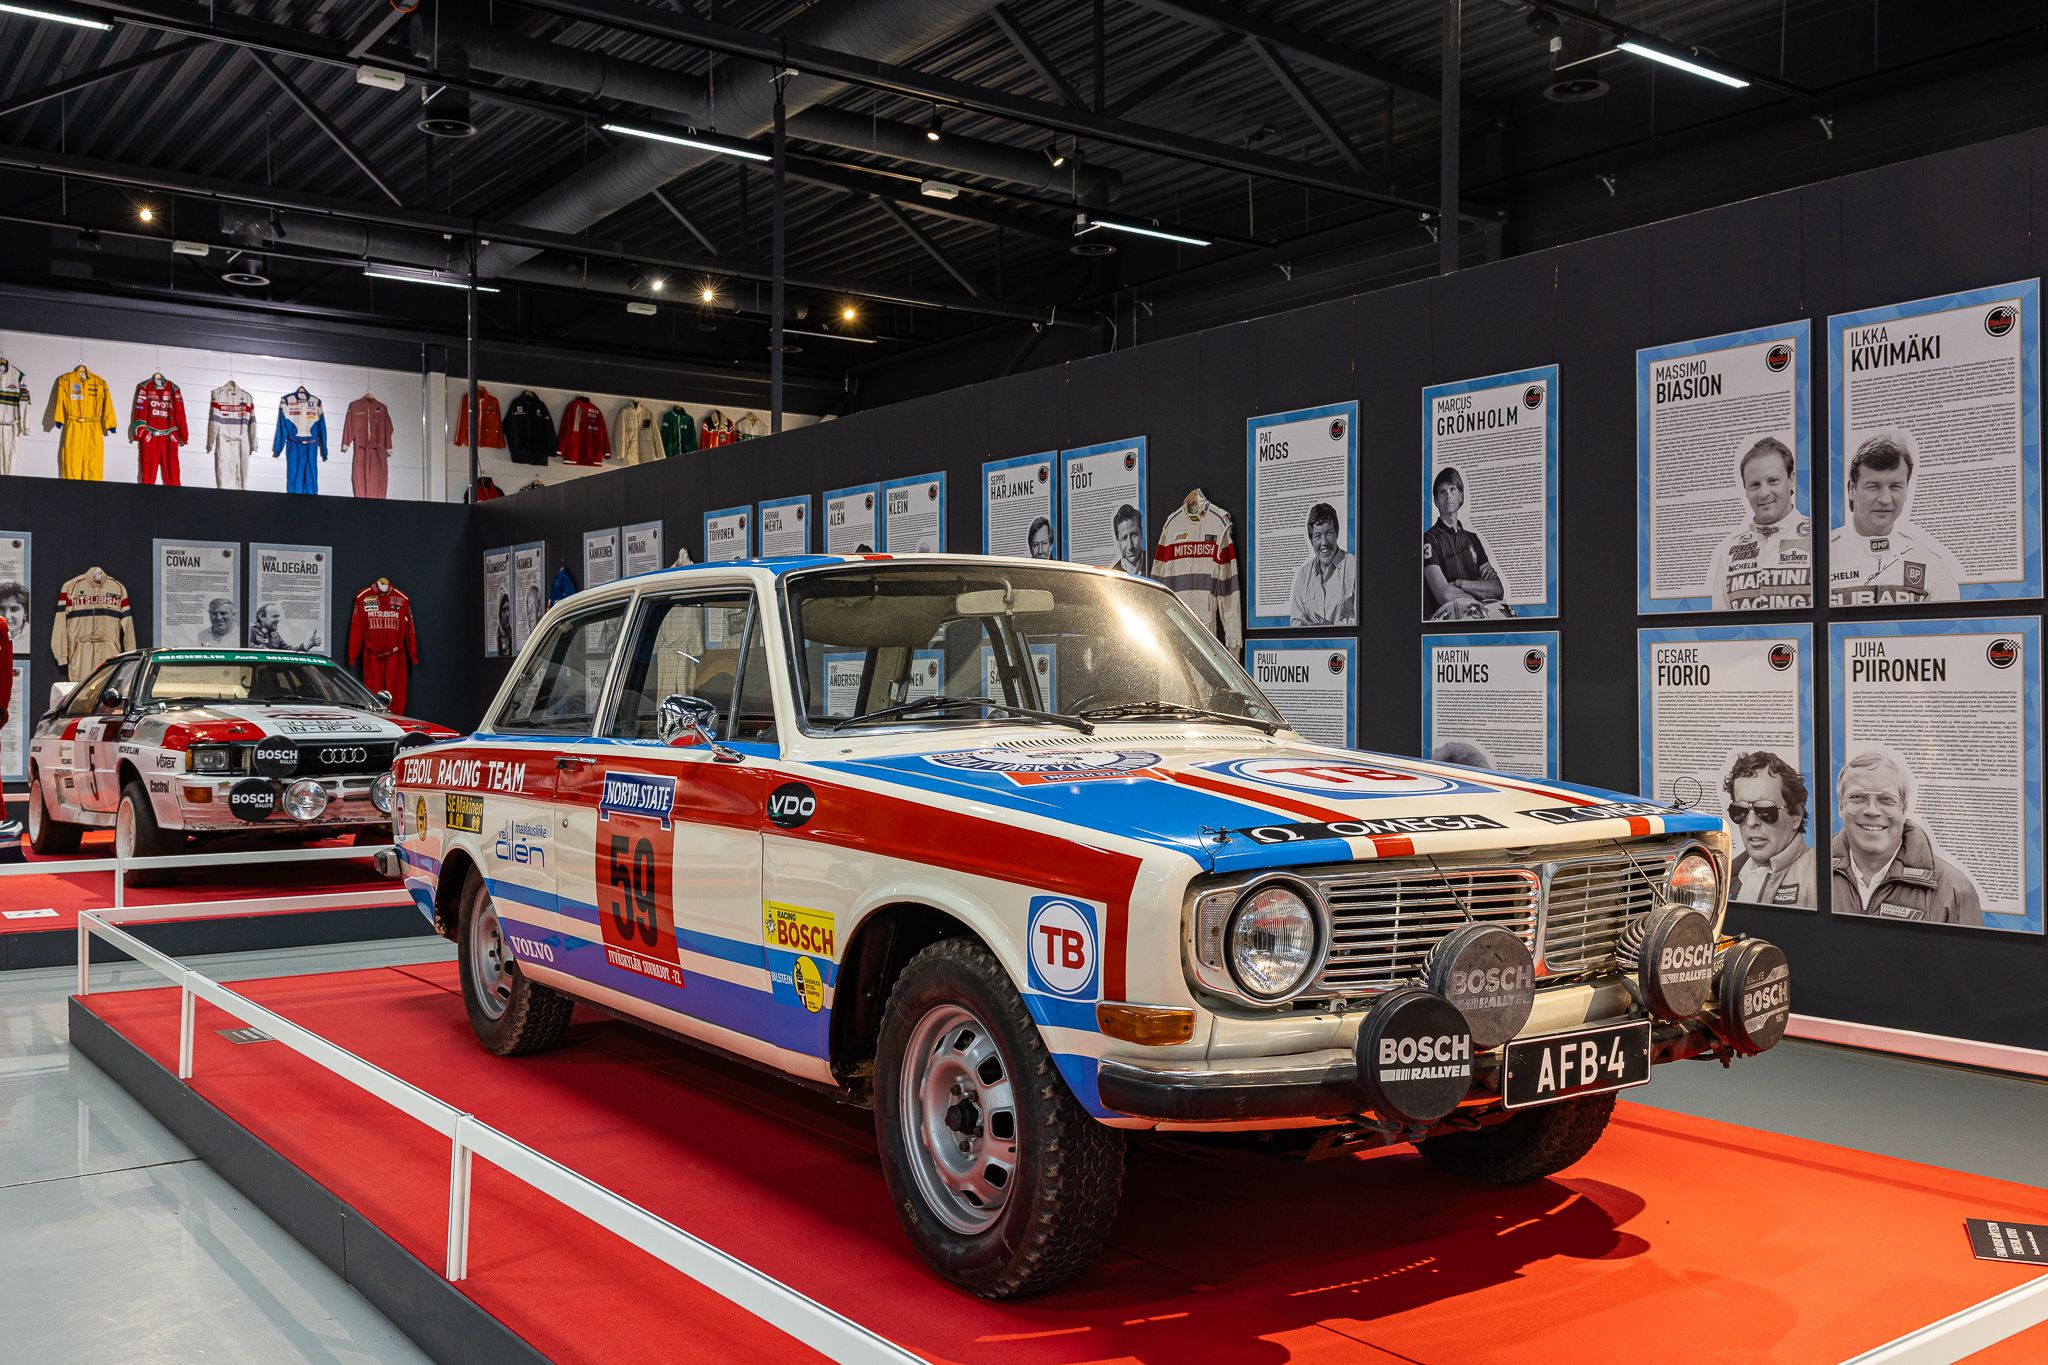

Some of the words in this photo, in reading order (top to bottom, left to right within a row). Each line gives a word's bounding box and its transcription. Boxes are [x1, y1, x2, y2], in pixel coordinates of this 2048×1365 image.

[1851, 326, 1888, 348] ILKKA
[1851, 334, 1941, 372] KIVIMÄKI
[1656, 360, 1707, 382] MASSIMO
[1656, 373, 1722, 404] BIASION
[1437, 396, 1472, 414] MARCUS
[1437, 406, 1518, 436] GRÖNHOLM
[1260, 431, 1272, 444] PAT
[1260, 442, 1289, 462] MOSS
[1070, 462, 1084, 475] JEAN
[991, 474, 1005, 485] SEPPO
[1070, 472, 1093, 490] TODT
[888, 490, 908, 501] REINHARD
[991, 480, 1034, 500] HARJANNE
[888, 500, 908, 515] KLEIN
[709, 527, 735, 542] TOIVONEN
[765, 519, 783, 532] MEHTA
[166, 556, 201, 568] COWAN
[262, 560, 319, 575] WALDEGÅRD
[1731, 569, 1808, 592] MARTINI
[1909, 568, 1921, 578] BP
[1437, 650, 1470, 663] MARTIN
[1657, 648, 1699, 664] CESARE
[1852, 641, 1886, 658] JUHA
[266, 655, 328, 665] MICHELIN
[1257, 653, 1278, 665] PAULI
[1257, 665, 1310, 683] TOIVONEN
[1437, 664, 1489, 683] HOLMES
[1658, 664, 1711, 687] FIORIO
[1853, 658, 1946, 683] PIIRONEN
[257, 749, 298, 760] BOSCH
[402, 758, 433, 784] TEBOIL
[437, 759, 482, 788] RACING
[486, 761, 527, 792] TEAM
[1255, 766, 1418, 784] TB
[150, 780, 170, 794] Castrol
[605, 780, 639, 808] NORTH
[638, 783, 671, 811] STATE
[232, 794, 274, 804] BOSCH
[771, 794, 816, 816] VDO
[1326, 815, 1497, 837] OMEGA
[610, 834, 658, 948] 59
[777, 910, 797, 922] RACING
[1882, 904, 1908, 914] TOYOTA
[776, 919, 834, 957] BOSCH
[1039, 924, 1085, 970] TB
[510, 935, 554, 963] VOLVO
[1661, 943, 1714, 970] BOSCH
[771, 971, 794, 986] BILSTEIN
[1452, 964, 1532, 995] BOSCH
[1677, 969, 1707, 983] RALLYE
[1743, 980, 1788, 1016] BOSCH
[1379, 1034, 1470, 1065] BOSCH
[1410, 1064, 1461, 1080] RALLYE
[1536, 1035, 1625, 1094] AFB-4
